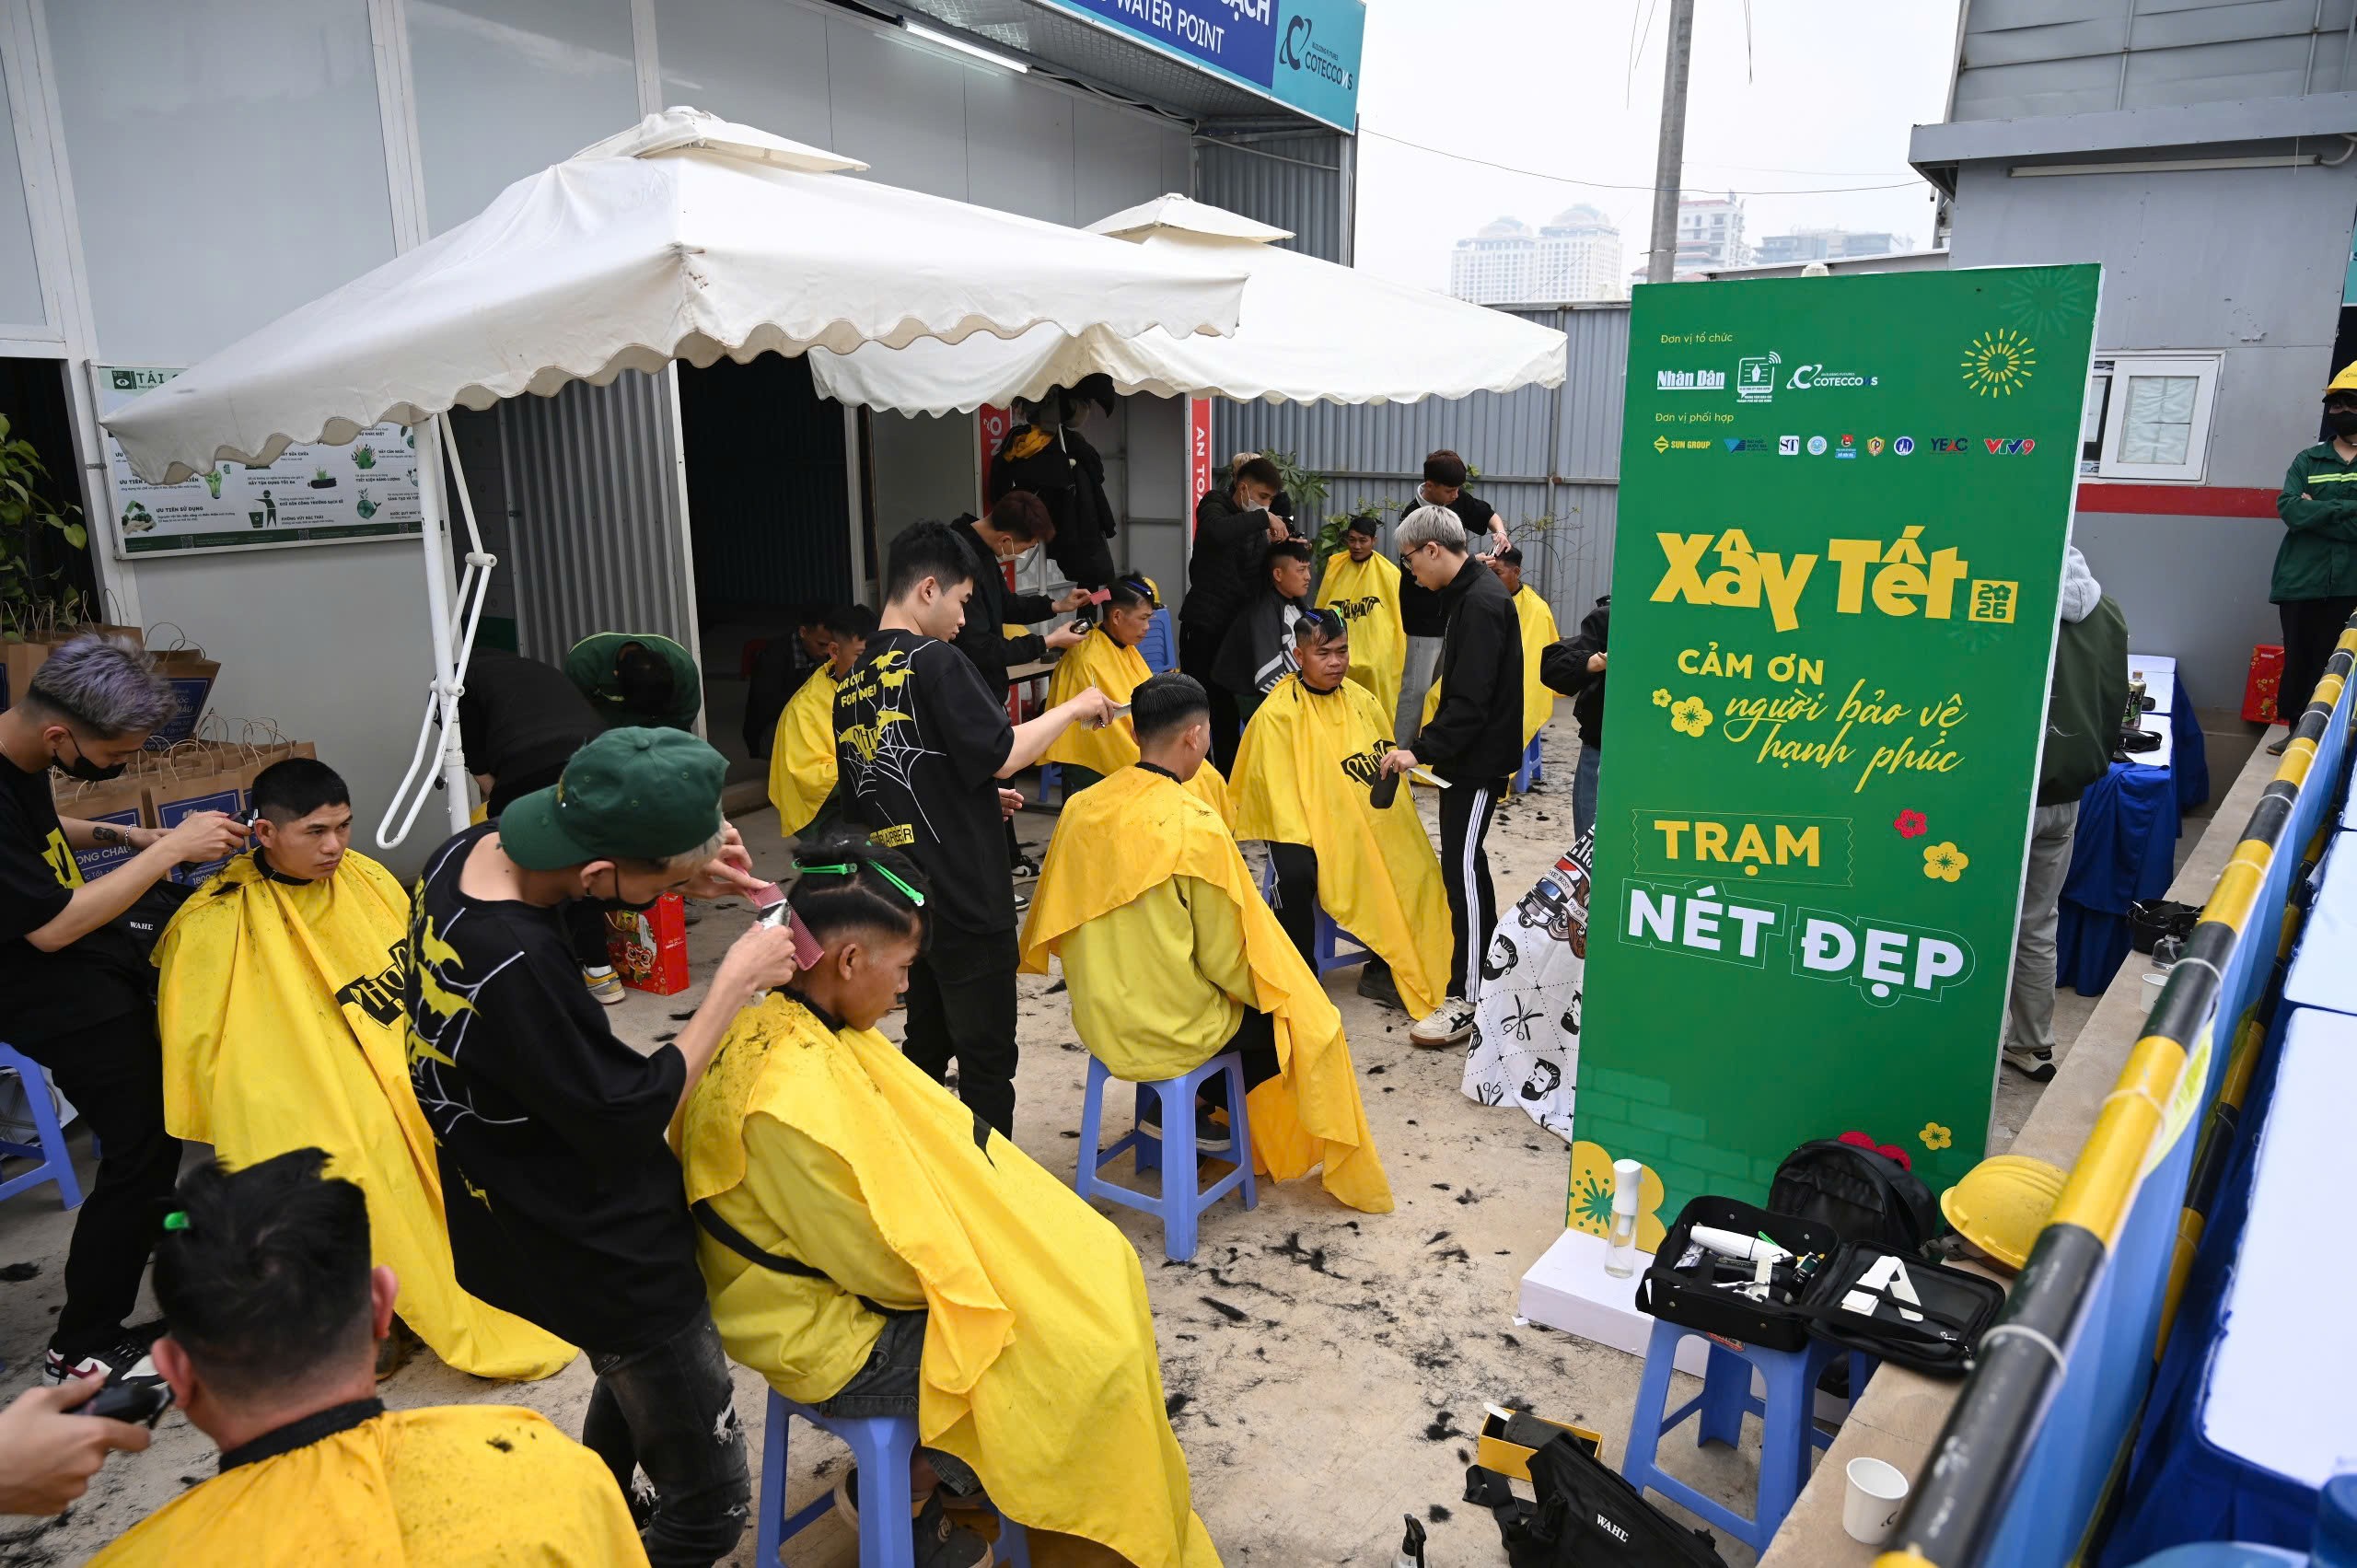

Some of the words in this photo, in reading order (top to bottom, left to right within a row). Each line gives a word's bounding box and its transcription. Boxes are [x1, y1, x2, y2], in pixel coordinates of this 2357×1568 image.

[1177, 8, 1225, 54] POINT
[1305, 52, 1353, 90] COTECCONS
[1661, 334, 1681, 343] Đơn
[1684, 333, 1692, 345] vị
[1696, 331, 1706, 343] tổ
[1709, 332, 1733, 343] chức
[136, 370, 165, 383] TÁI
[1657, 370, 1694, 387] Nhân
[1697, 370, 1724, 387] Dân
[1813, 377, 1878, 387] COTECCONS
[1655, 413, 1676, 422] Đơn
[1678, 412, 1687, 424] vị
[1689, 411, 1712, 424] phối
[1714, 412, 1735, 424] hợp
[1196, 426, 1205, 457] AN
[1671, 440, 1686, 449] SUN
[1687, 440, 1711, 449] GROUP
[1780, 439, 1799, 452] ST
[1983, 437, 2036, 455] VTV9
[1649, 528, 1819, 633] Xây
[1828, 526, 1968, 620] Tết
[1678, 642, 1753, 679] CẢM
[1767, 653, 1824, 686] ƠN
[850, 669, 865, 687] CUT
[841, 691, 856, 708] FOR
[1723, 688, 1829, 743] người
[1835, 679, 1912, 725] bảo
[1919, 693, 1968, 737] vệ
[1756, 720, 1857, 769] hạnh
[1853, 737, 1966, 794] phúc
[1654, 820, 1820, 877] TRẠM
[76, 852, 99, 865] ONG
[130, 921, 154, 931] WAHL
[1628, 885, 1775, 958] NÉT
[1801, 918, 1964, 998] ĐẸP
[1596, 1513, 1629, 1543] WAHL
